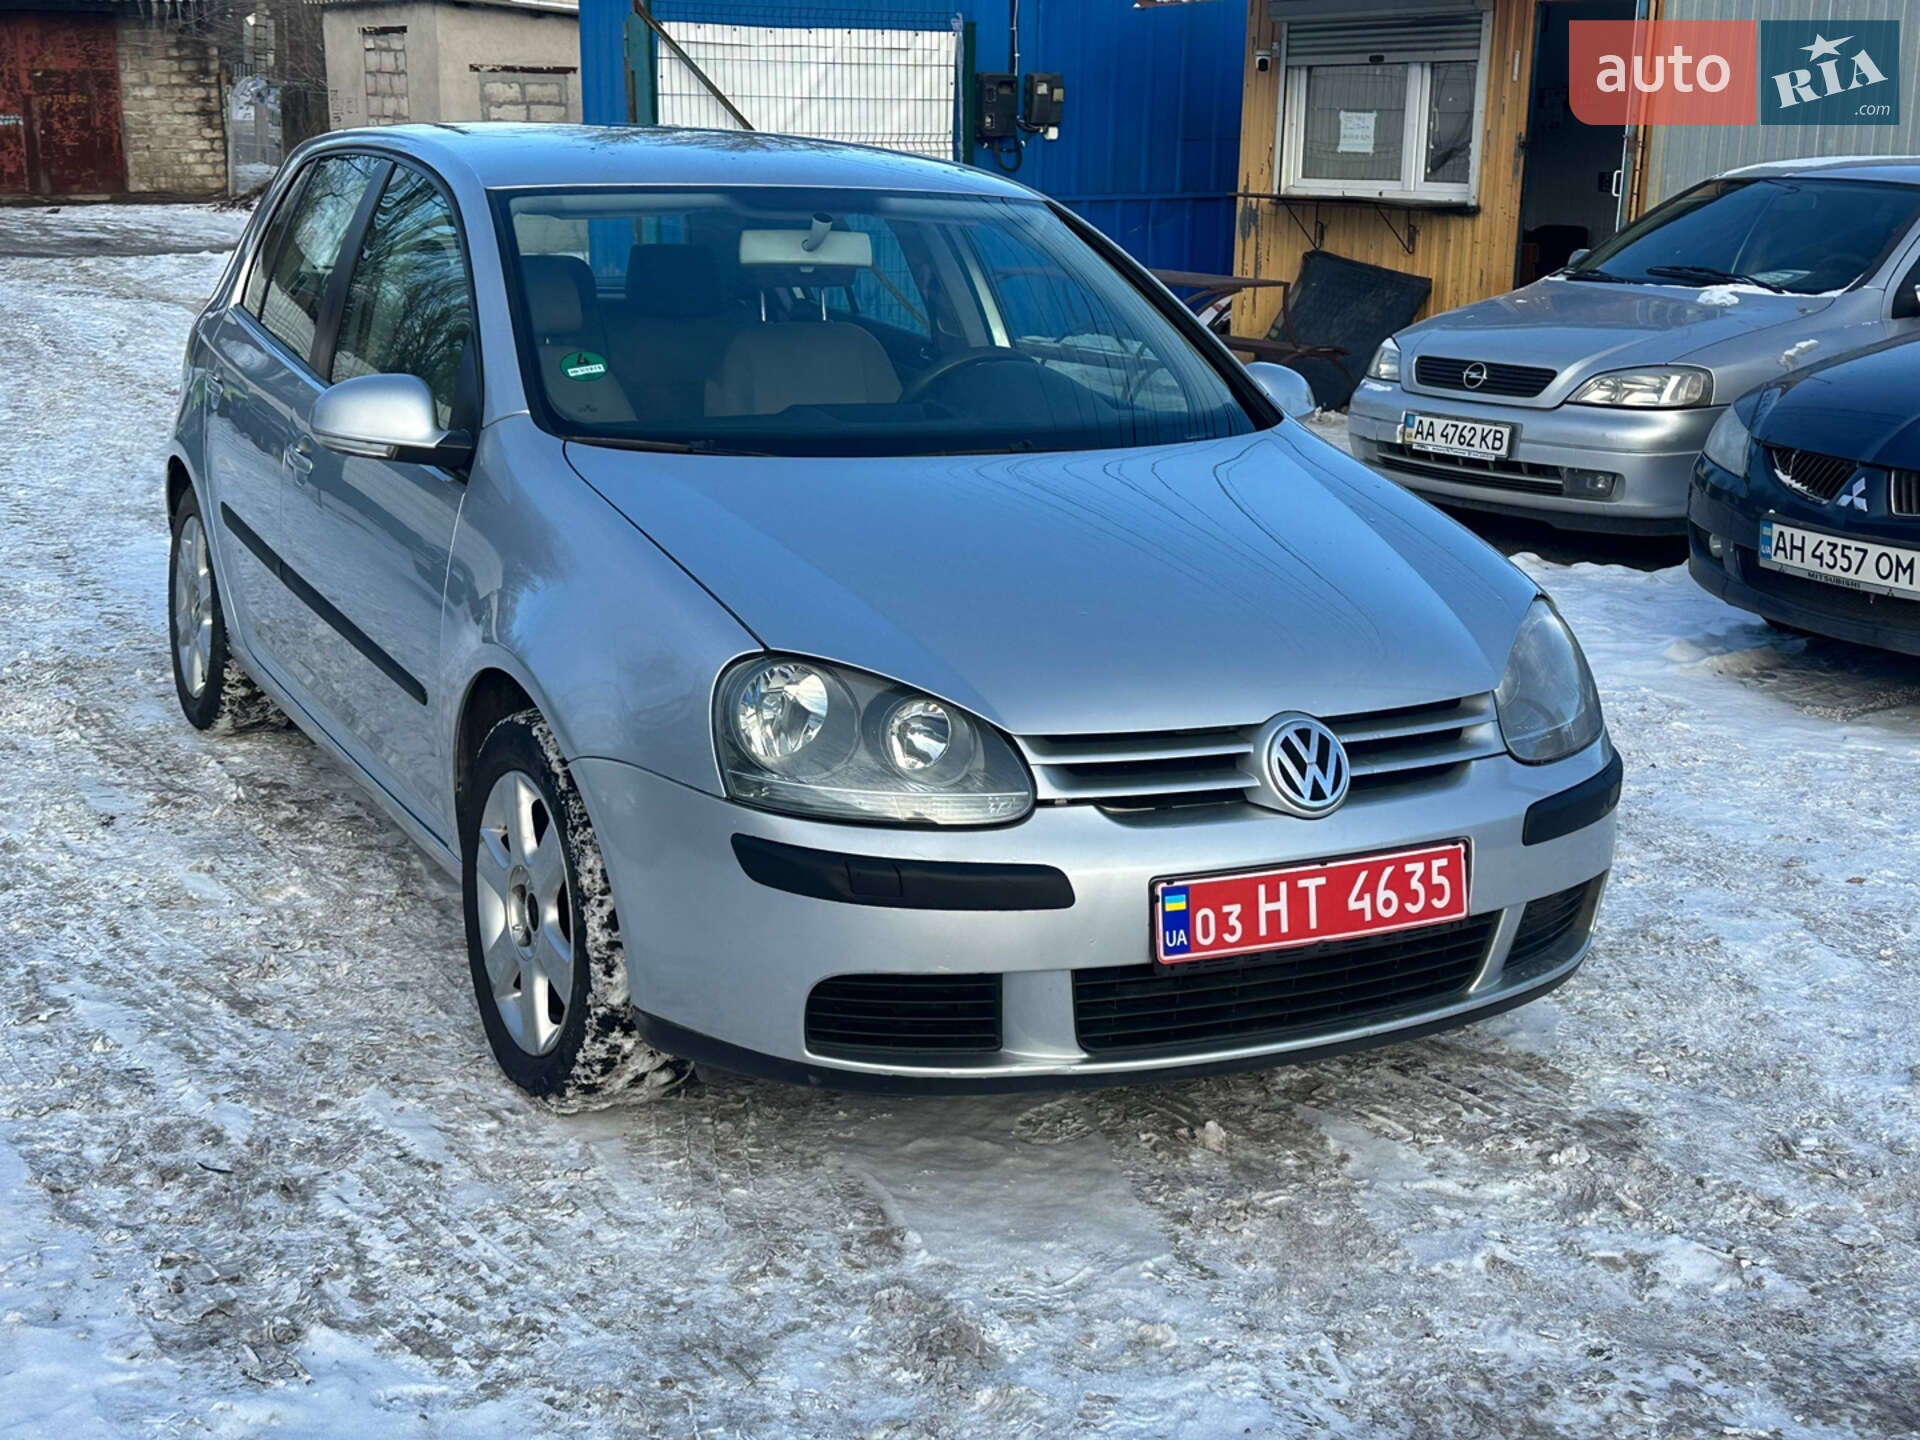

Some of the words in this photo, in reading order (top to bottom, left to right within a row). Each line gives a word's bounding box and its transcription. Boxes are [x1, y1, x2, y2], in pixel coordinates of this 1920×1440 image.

[1414, 419, 1436, 442] AA
[1440, 423, 1477, 448] 4762
[1479, 427, 1504, 451] KB
[1773, 530, 1806, 563] AH
[1811, 539, 1869, 575] 4357
[1875, 551, 1916, 586] OM
[1195, 903, 1243, 946] 03
[1257, 876, 1327, 937] HT
[1347, 857, 1452, 922] 4635
[1165, 928, 1188, 947] UA
